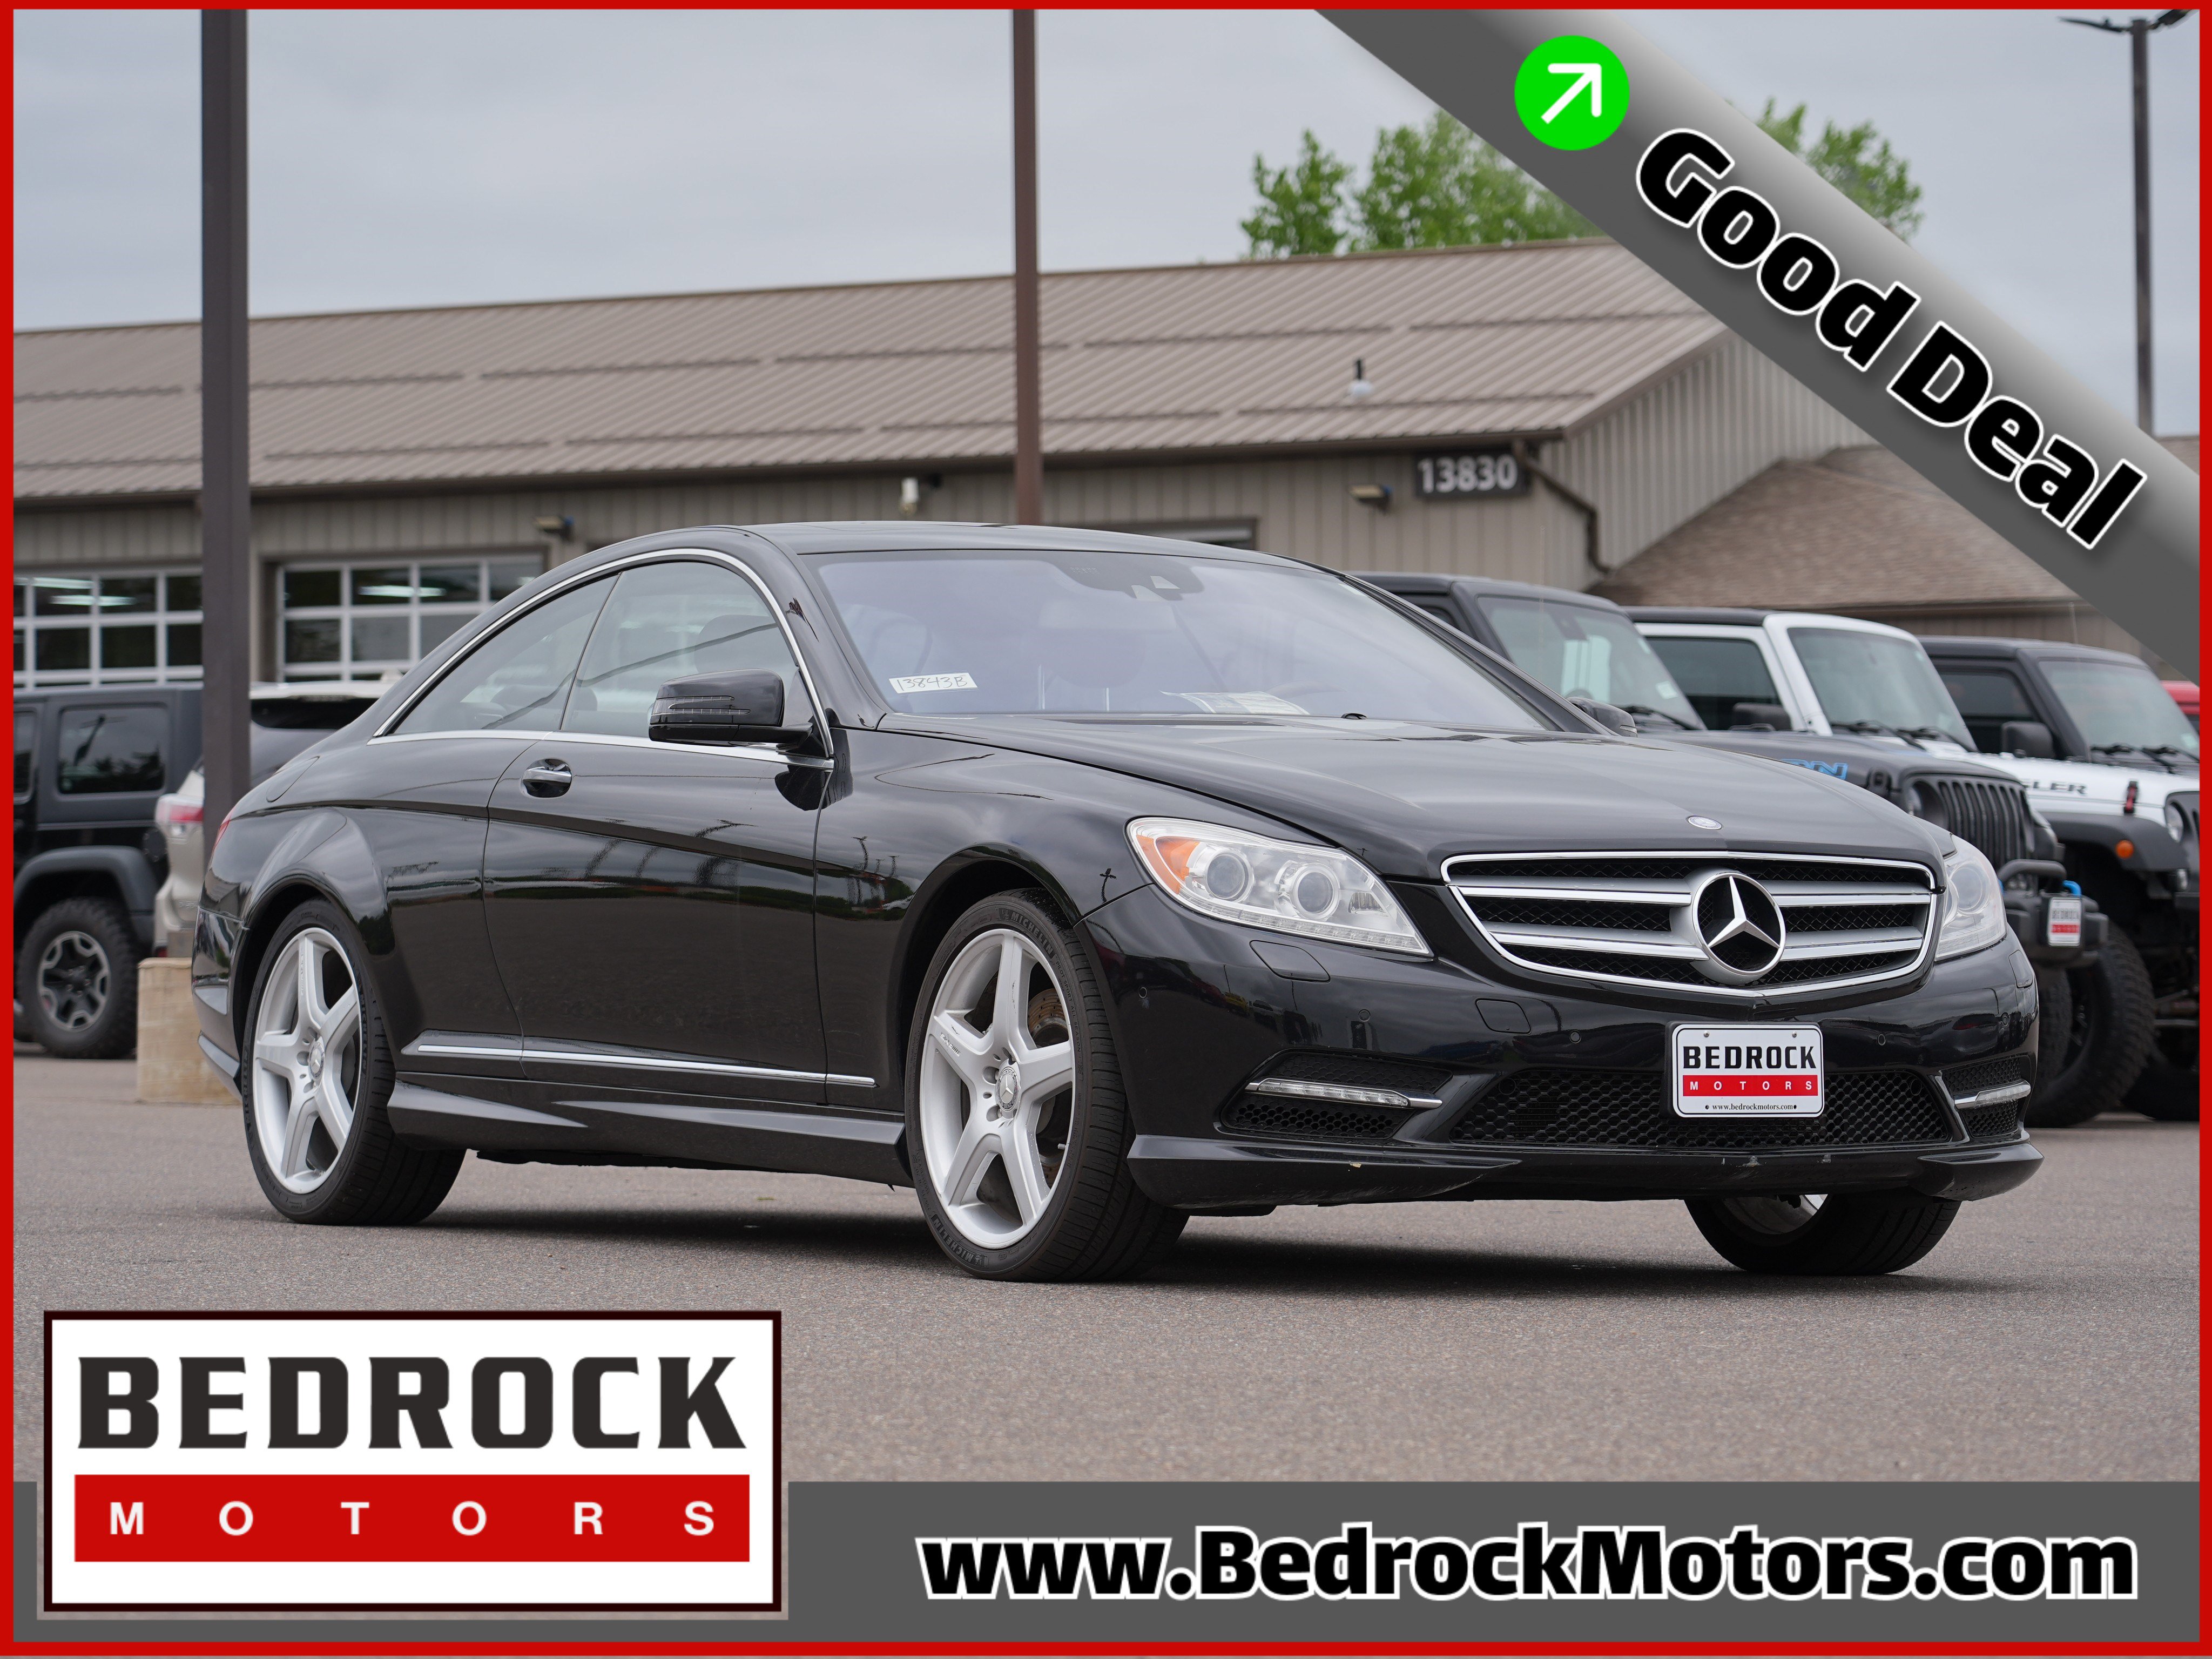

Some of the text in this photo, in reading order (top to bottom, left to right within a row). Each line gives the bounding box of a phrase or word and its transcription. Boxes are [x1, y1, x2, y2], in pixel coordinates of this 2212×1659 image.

[1417, 454, 1518, 494] 13830
[896, 677, 968, 691] 13843B
[1010, 912, 1054, 955] MICHELIN
[1056, 961, 1065, 978] PILOT
[1063, 980, 1073, 1001] SPORT
[1683, 1046, 1817, 1069] BEDROCK
[1690, 1081, 1812, 1090] MOTORS
[934, 1219, 975, 1263] MICHELIN
